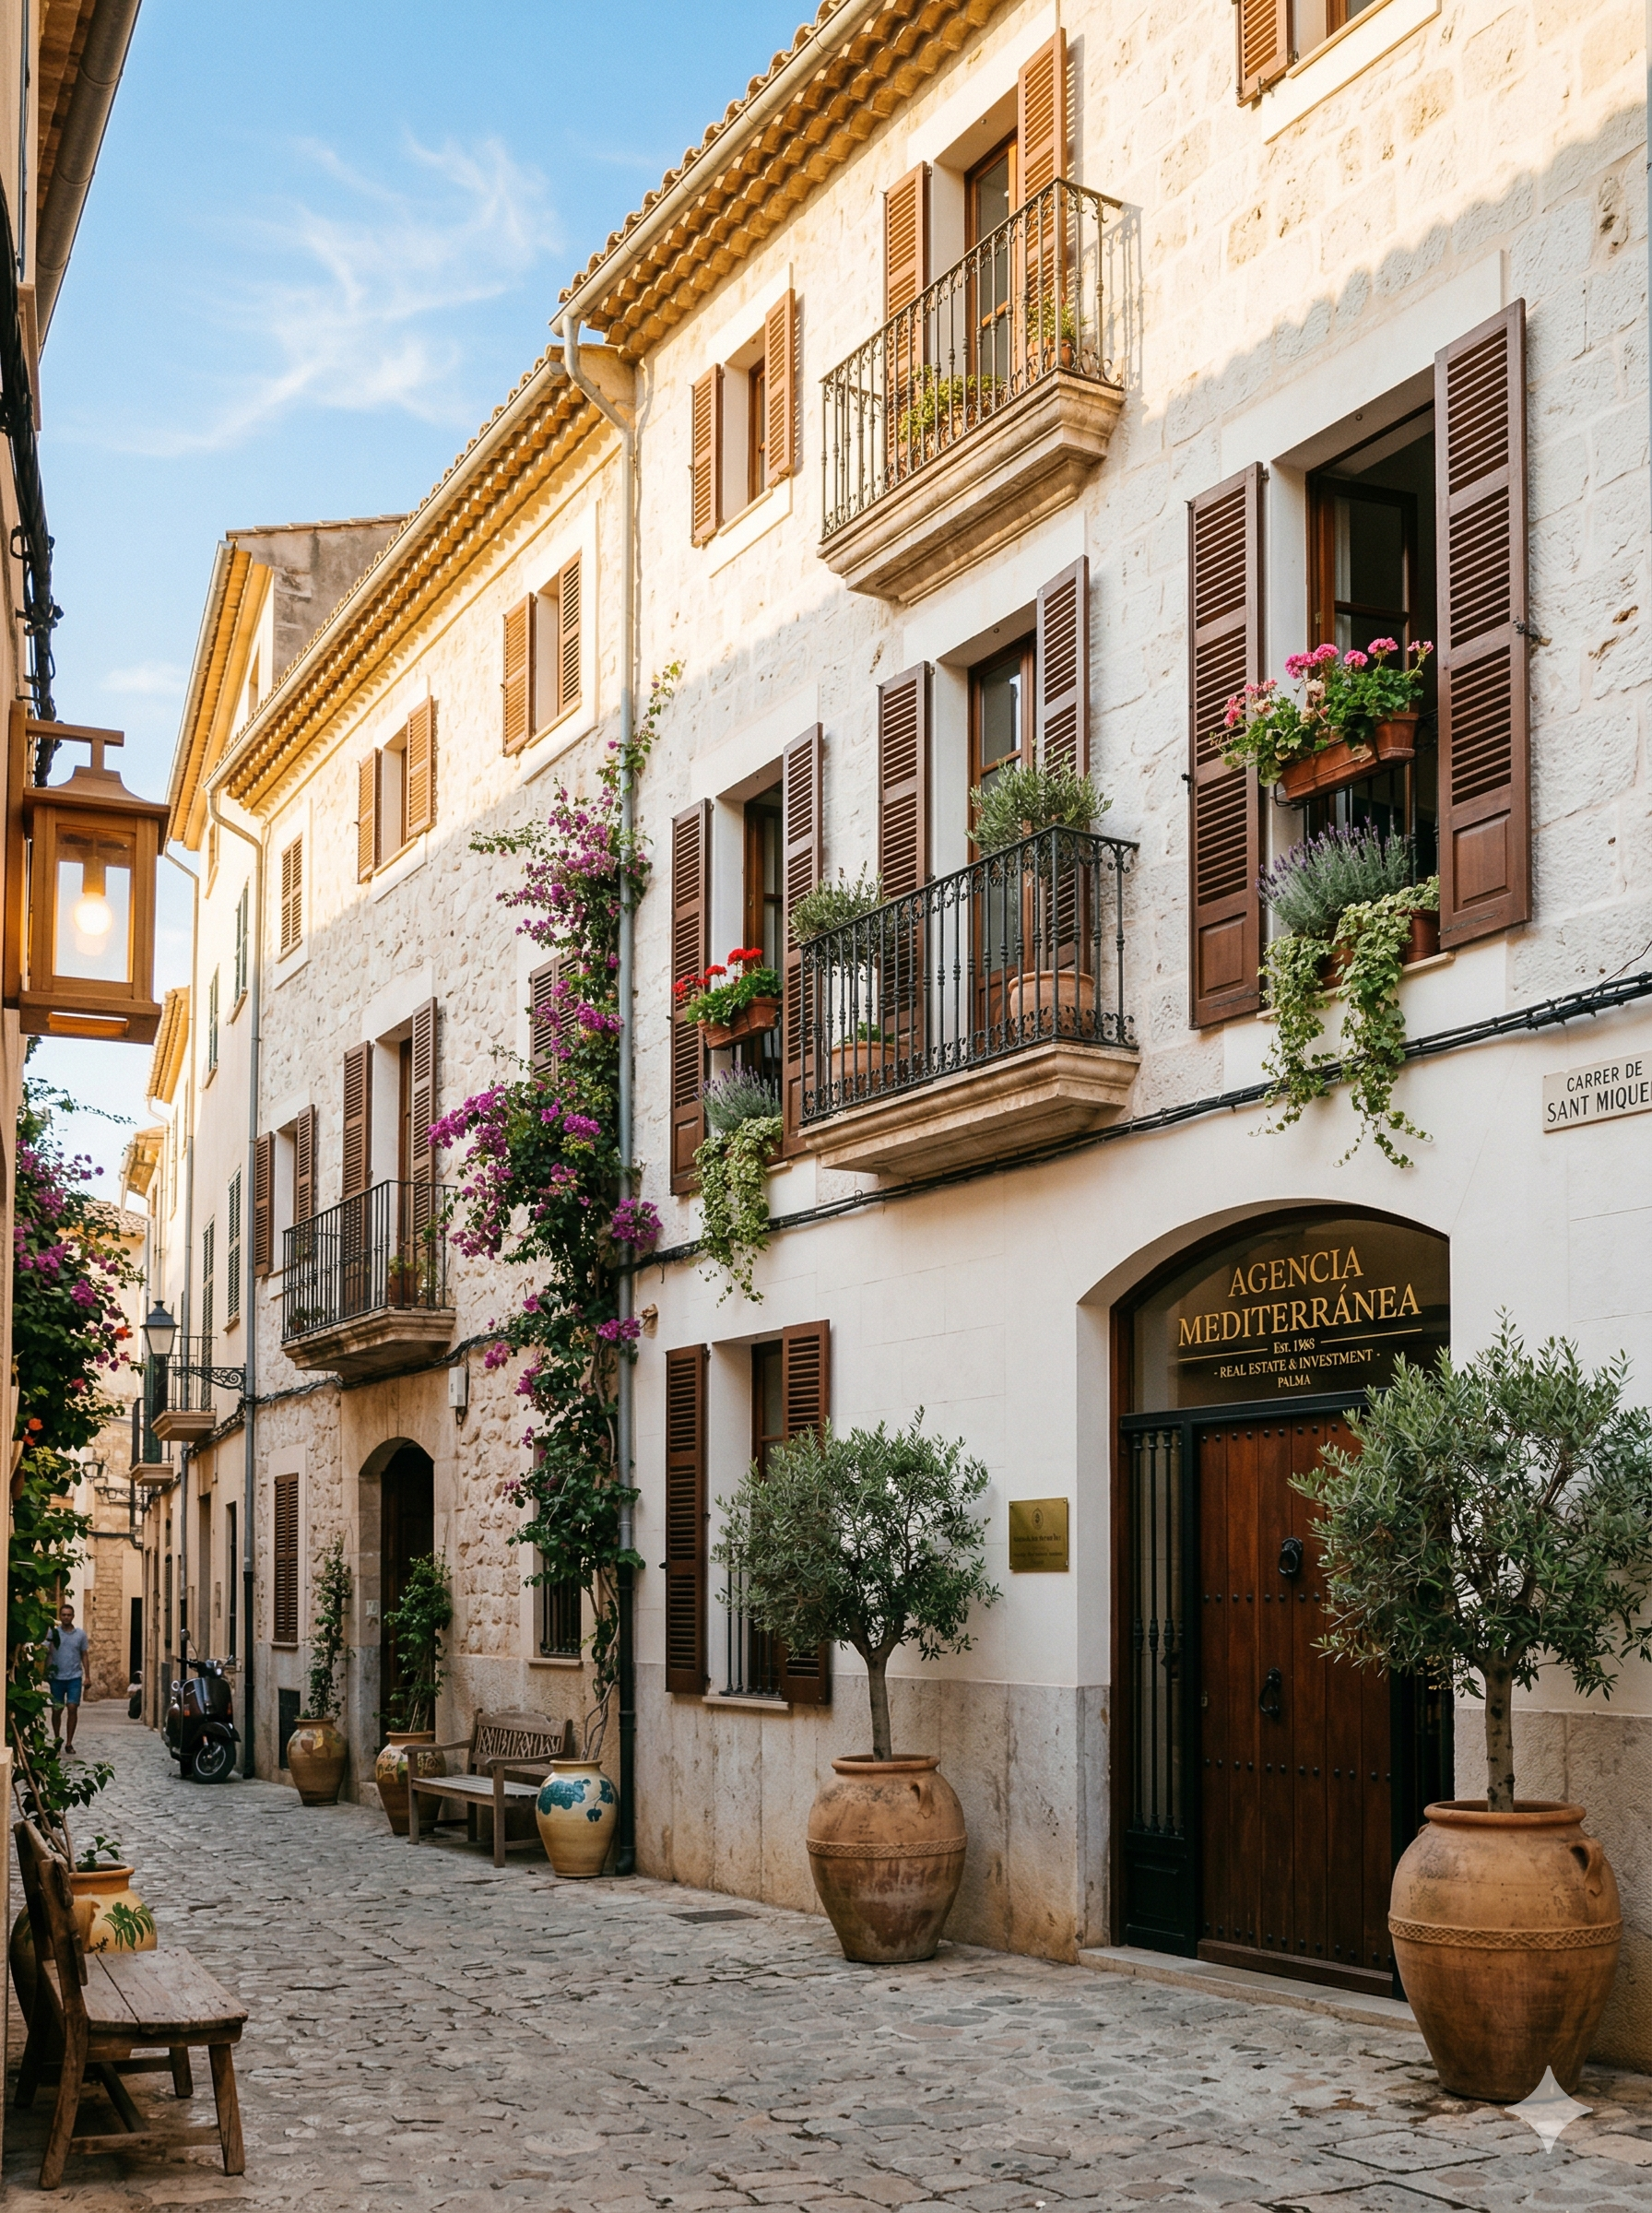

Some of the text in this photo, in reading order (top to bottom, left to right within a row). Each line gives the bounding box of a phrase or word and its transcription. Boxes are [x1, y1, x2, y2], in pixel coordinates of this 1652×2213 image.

[1567, 1060, 1643, 1092] CARRER DE
[1547, 1082, 1652, 1123] SANT MIQUE
[1228, 1246, 1363, 1297] AGENCIA
[1178, 1283, 1422, 1346] MEDITERRÁNEA
[1220, 1349, 1374, 1378] REAL ESTATE & INVESTMENT
[1277, 1375, 1312, 1389] PALMA
